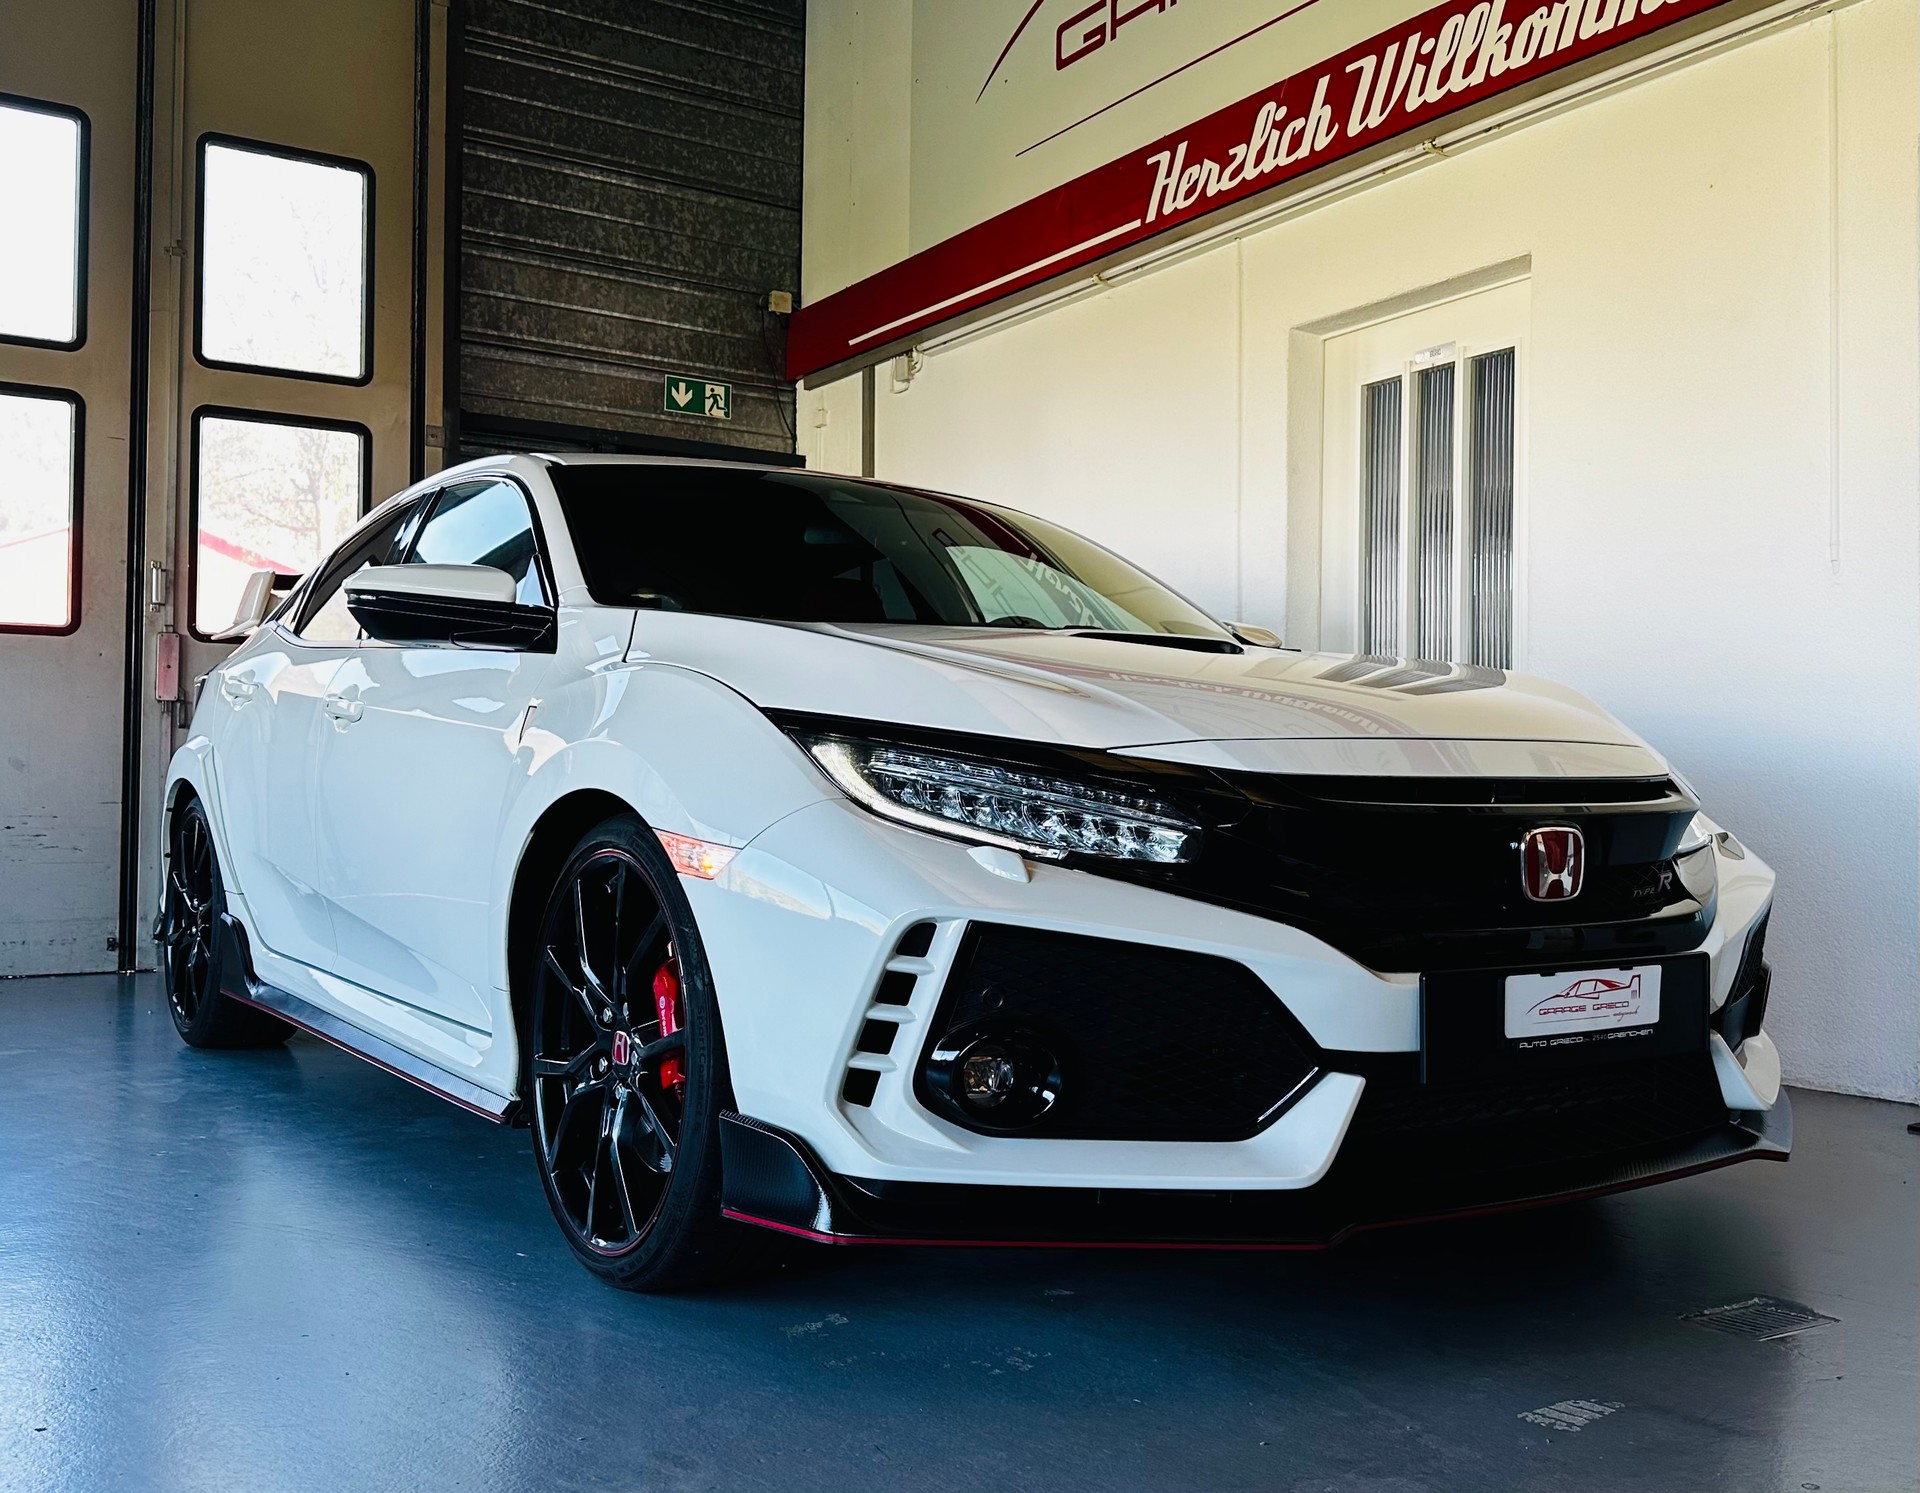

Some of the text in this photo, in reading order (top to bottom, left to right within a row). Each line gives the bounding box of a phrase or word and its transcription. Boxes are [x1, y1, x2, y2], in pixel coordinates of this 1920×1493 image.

[1145, 74, 1340, 224] Herzlich
[1657, 870, 1673, 892] R
[1538, 1000, 1630, 1016] GARAGE GRECO
[1519, 1040, 1547, 1049] AUTO
[1549, 1036, 1584, 1046] GRECO
